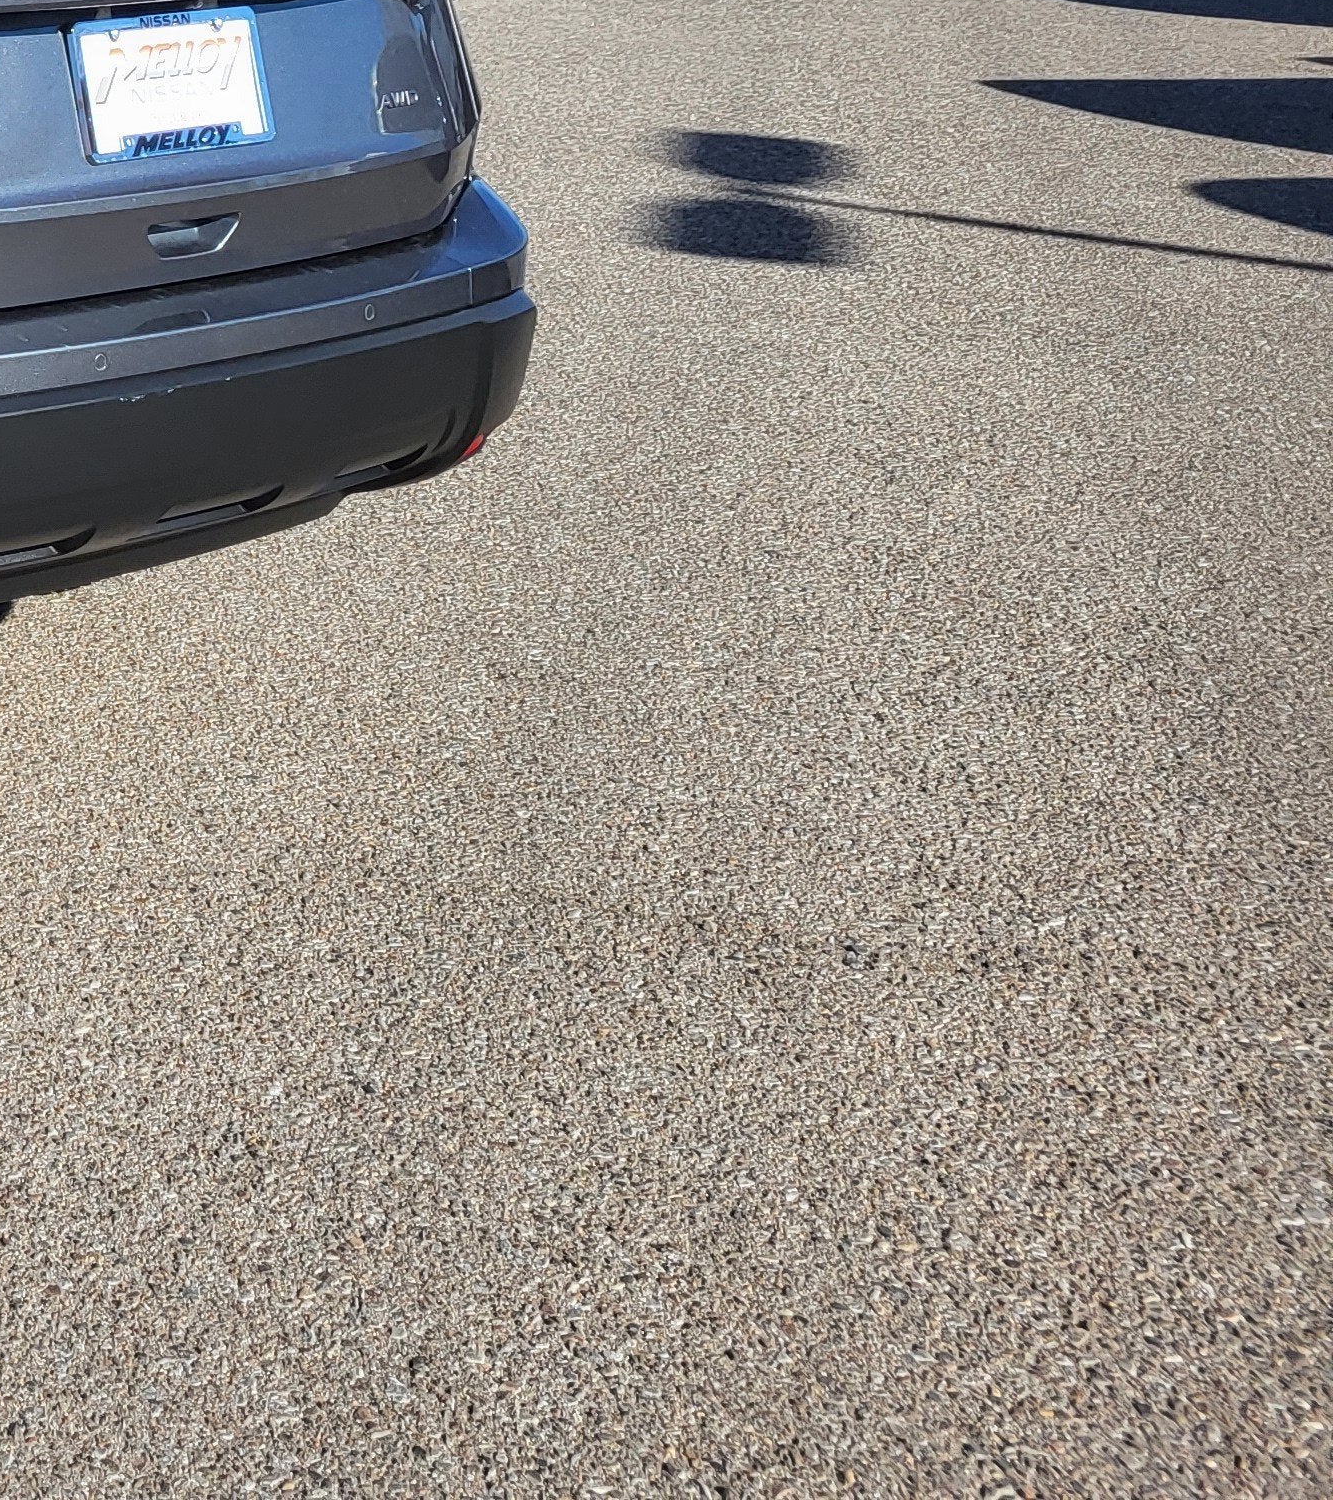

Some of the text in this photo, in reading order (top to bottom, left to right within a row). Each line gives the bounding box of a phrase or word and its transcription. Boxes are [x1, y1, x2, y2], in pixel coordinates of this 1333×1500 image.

[138, 13, 191, 29] NISSAN
[95, 35, 242, 105] MELLOY
[133, 123, 231, 157] MELLOY
